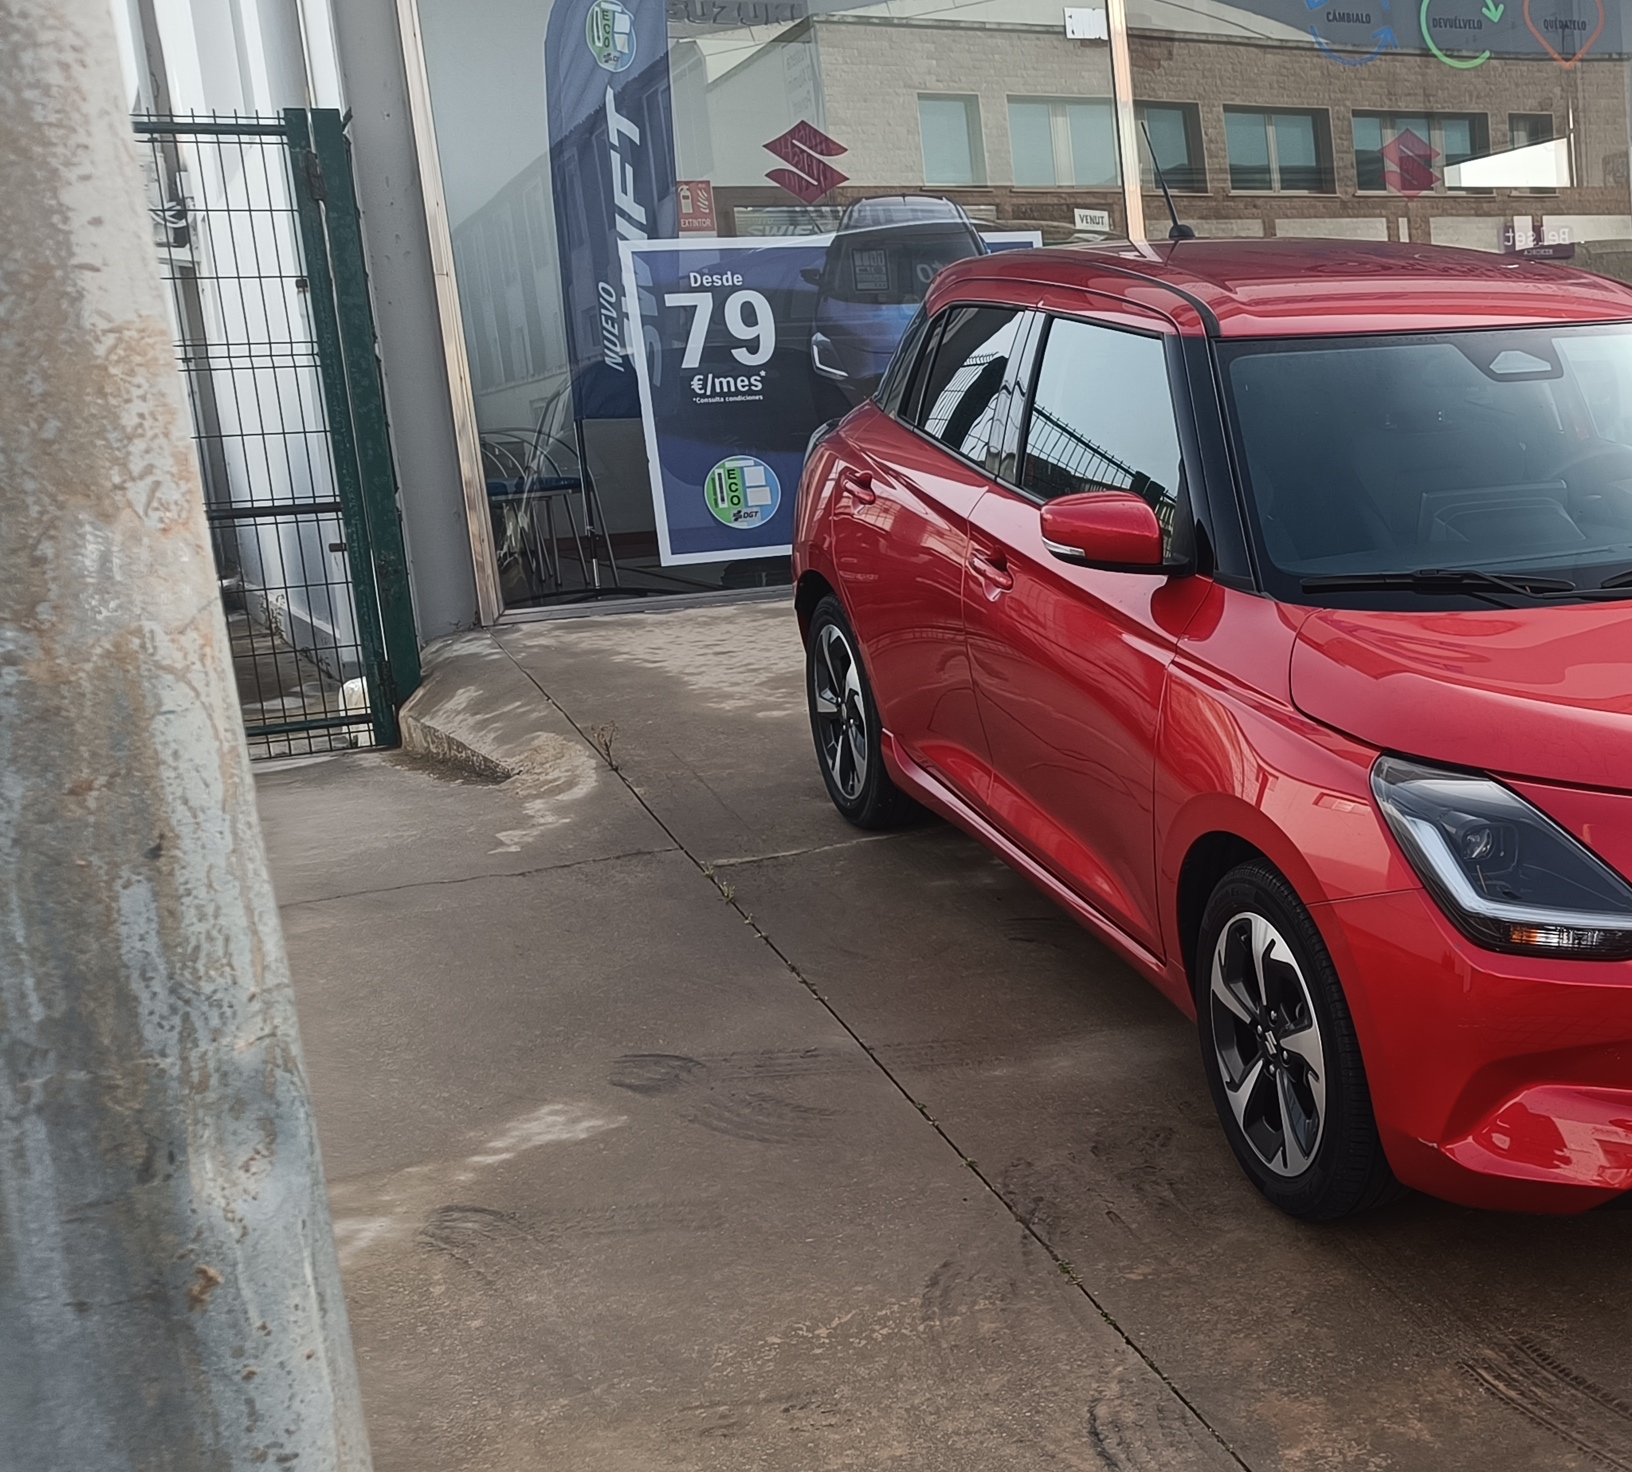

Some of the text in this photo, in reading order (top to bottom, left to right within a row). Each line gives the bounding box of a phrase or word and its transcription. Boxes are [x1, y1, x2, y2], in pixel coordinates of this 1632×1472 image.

[1326, 11, 1371, 24] CÁMBIALO
[1432, 17, 1482, 30] DEVUÉLVELO
[681, 218, 711, 228] EXTINTOR
[1079, 214, 1105, 225] VENUT
[690, 271, 743, 287] Desde
[598, 282, 624, 372] NUEVO
[664, 289, 776, 369] 79
[725, 394, 763, 402] condiciones
[727, 468, 741, 506] ECO
[743, 510, 759, 519] DGT
